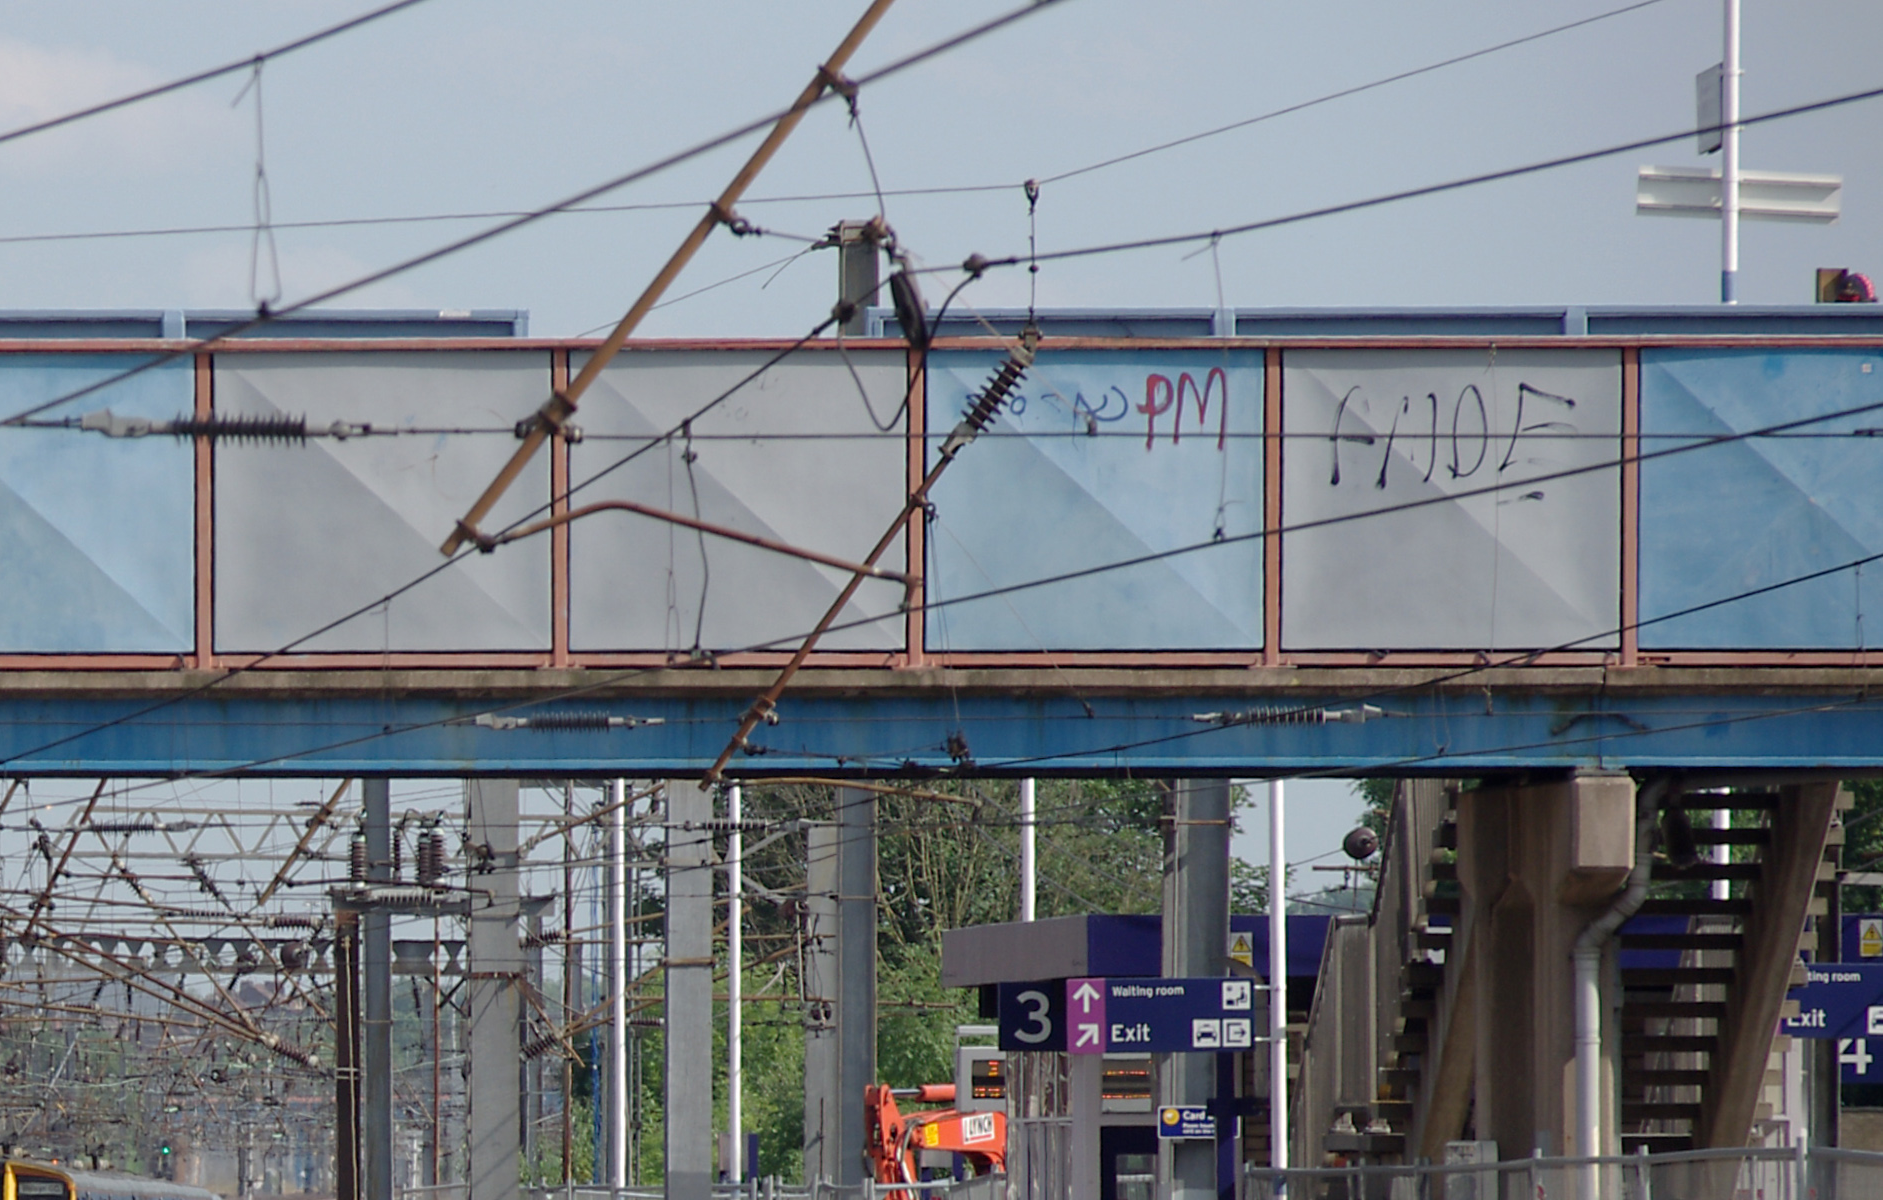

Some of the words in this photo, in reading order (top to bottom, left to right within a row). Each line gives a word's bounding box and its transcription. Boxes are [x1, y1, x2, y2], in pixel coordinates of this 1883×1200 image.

[1831, 972, 1861, 982] room
[1111, 985, 1153, 999] Waiting
[1155, 986, 1184, 997] room
[1013, 989, 1053, 1044] 3
[1111, 1023, 1151, 1043] Exit
[1182, 1110, 1206, 1121] Card
